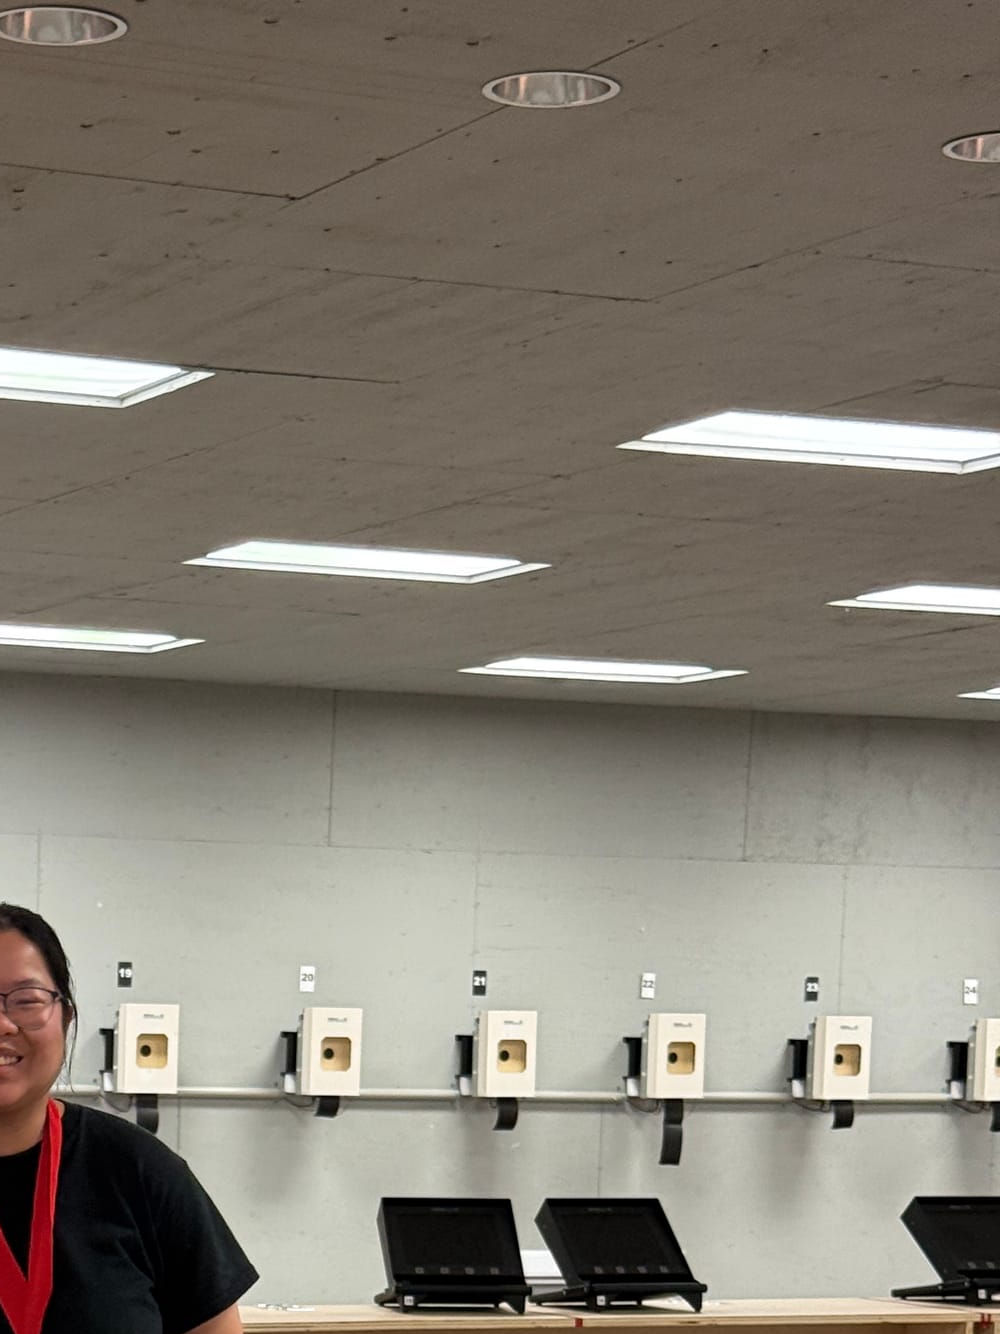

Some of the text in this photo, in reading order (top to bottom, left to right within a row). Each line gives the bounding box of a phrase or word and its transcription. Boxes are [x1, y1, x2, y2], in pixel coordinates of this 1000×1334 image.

[118, 968, 132, 978] 19
[301, 973, 314, 982] 20
[473, 976, 486, 986] 21
